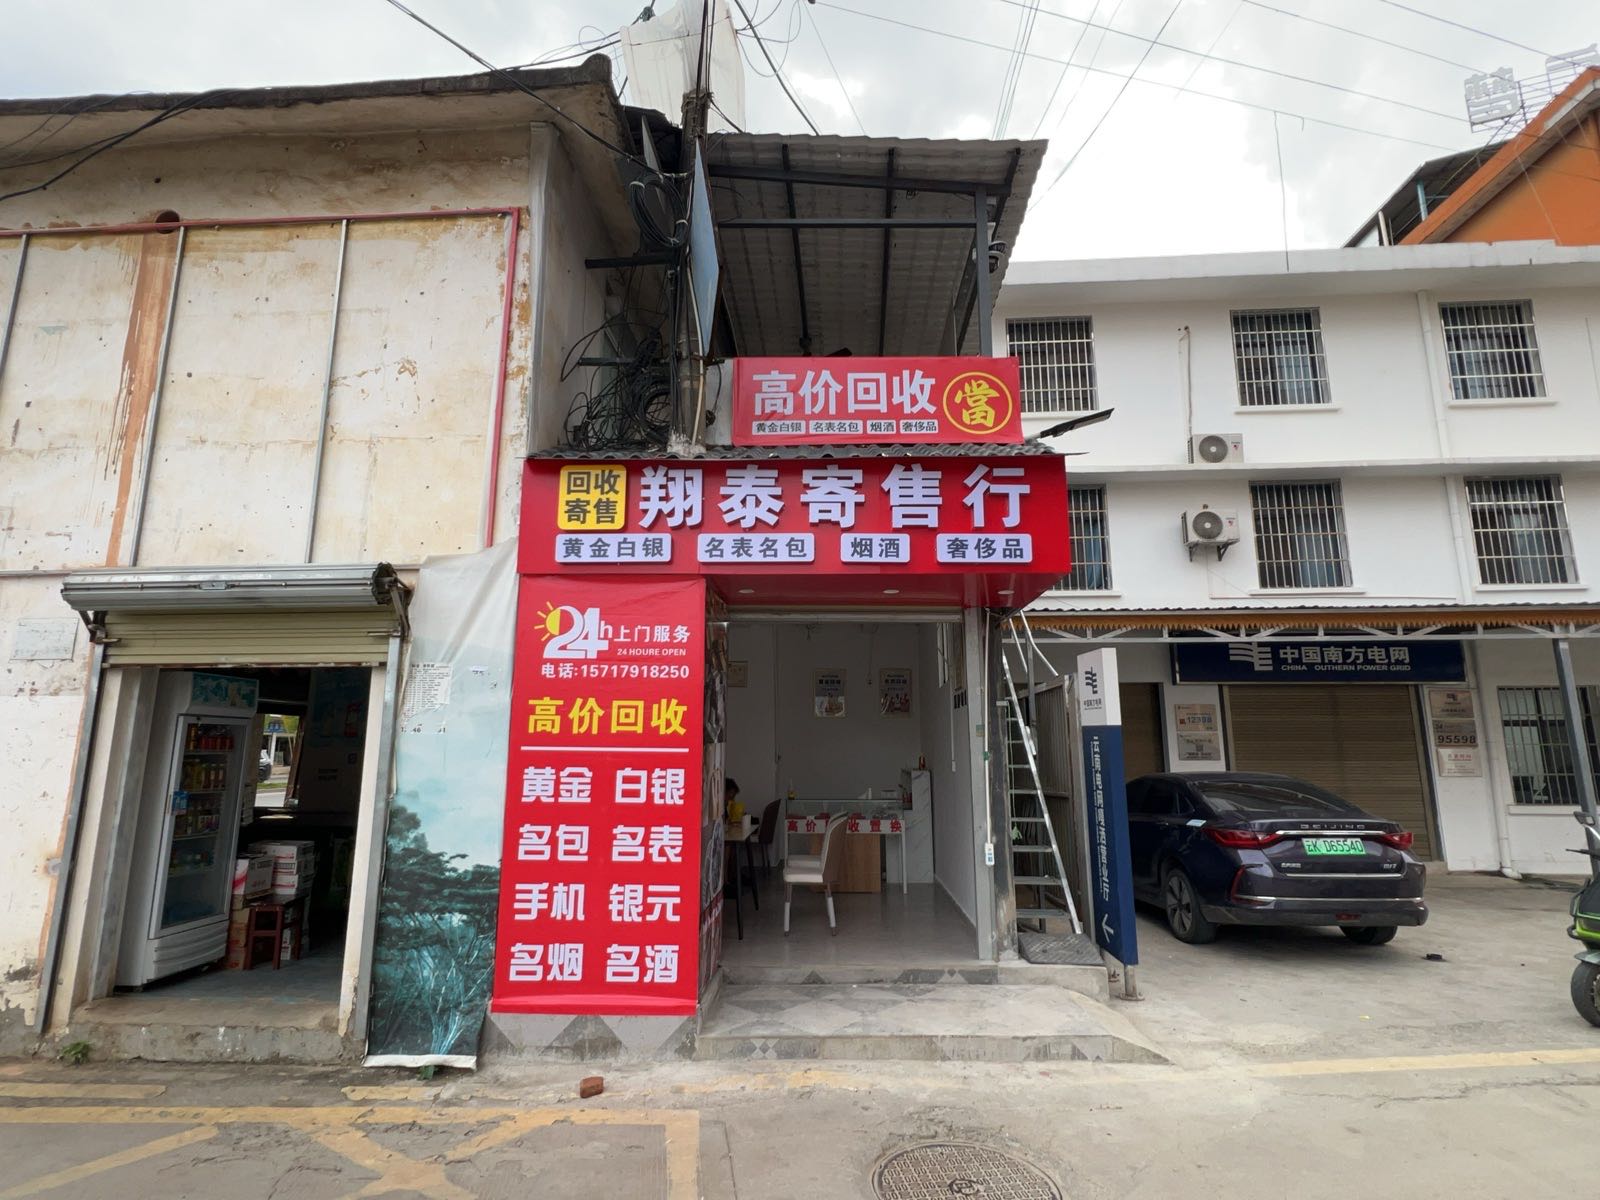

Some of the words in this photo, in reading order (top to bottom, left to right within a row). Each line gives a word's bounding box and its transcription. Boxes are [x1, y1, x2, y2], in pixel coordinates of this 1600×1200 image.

[752, 369, 937, 416] 高价回收
[954, 379, 1000, 428] 當
[756, 422, 802, 433] 黄金白银
[813, 422, 859, 432] 名表名包
[870, 421, 895, 432] 烟酒
[902, 421, 937, 432] 奢侈品
[566, 469, 620, 495] 回收
[639, 463, 1030, 529] 翔泰寄售行
[564, 498, 618, 524] 寄售
[563, 537, 664, 558] 黄金白银
[705, 537, 807, 558] 名表名包
[850, 537, 900, 559] 烟酒
[947, 537, 1025, 559] 奢侈品
[614, 625, 690, 643] 上门服务
[617, 648, 627, 656] 24
[629, 648, 660, 656] HOURE
[662, 648, 686, 656] OPEN
[1279, 646, 1410, 663] 中国南方电网
[528, 697, 688, 735] 高价回收
[1438, 735, 1477, 744] 95598
[521, 766, 593, 803] 黄金
[615, 767, 685, 804] 白银
[517, 824, 590, 861] 名包
[612, 825, 683, 862] 名表
[513, 883, 585, 920] 手机
[609, 884, 681, 922] 银元
[509, 943, 584, 981] 名烟
[606, 944, 680, 983] 名酒
